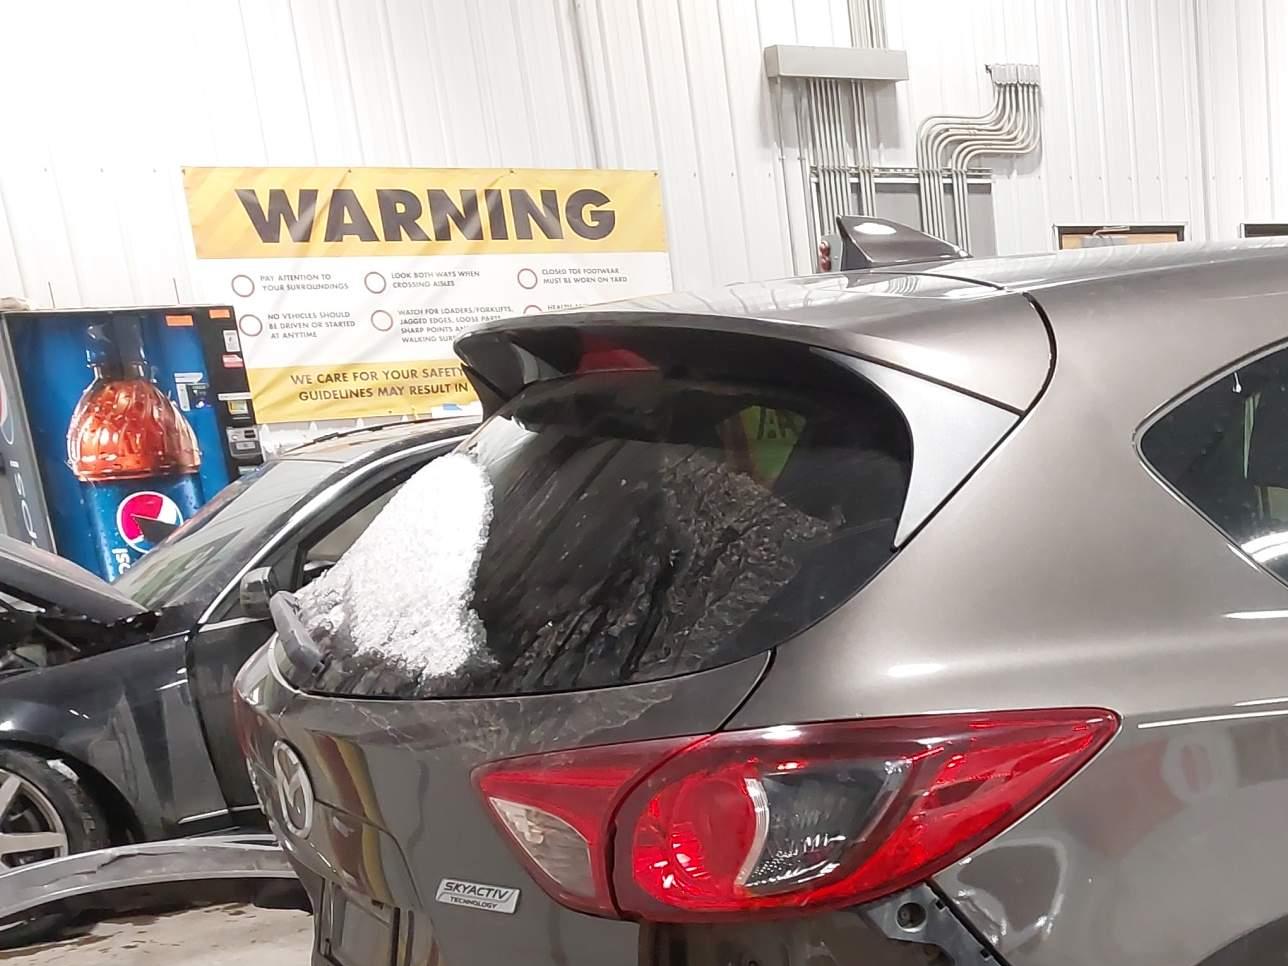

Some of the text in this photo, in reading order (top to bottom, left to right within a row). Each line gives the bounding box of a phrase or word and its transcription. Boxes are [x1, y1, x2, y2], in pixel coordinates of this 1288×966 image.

[234, 188, 616, 244] WARNING
[414, 271, 434, 279] BOTH
[458, 270, 480, 278] WHEN
[583, 267, 619, 275] FOOTWEAR
[278, 273, 319, 281] ATTENTION
[543, 276, 562, 284] MUST
[611, 275, 627, 283] YARD
[262, 282, 349, 292] YOUR SURROUNDINGS
[392, 281, 431, 289] CROSSING
[282, 311, 317, 320] VEHICLES
[320, 311, 350, 319] SHOULD
[398, 308, 423, 316] WATCH
[425, 307, 439, 315] FOR
[280, 321, 309, 330] DRIVEN
[325, 320, 356, 328] STARTED
[400, 317, 427, 326] JAGGED
[456, 315, 479, 323] LOOSE
[401, 327, 424, 335] SHARP
[426, 326, 453, 334] POINTS
[282, 331, 317, 340] ANYTIME
[402, 335, 437, 344] WALKING
[291, 367, 464, 385] WE CARE FOR YOUR SAFETY
[299, 382, 468, 401] GUIDELINES MAY RESULT IN
[444, 881, 509, 900] SKYACTIV
[450, 896, 498, 909] TECHNOLOGY
